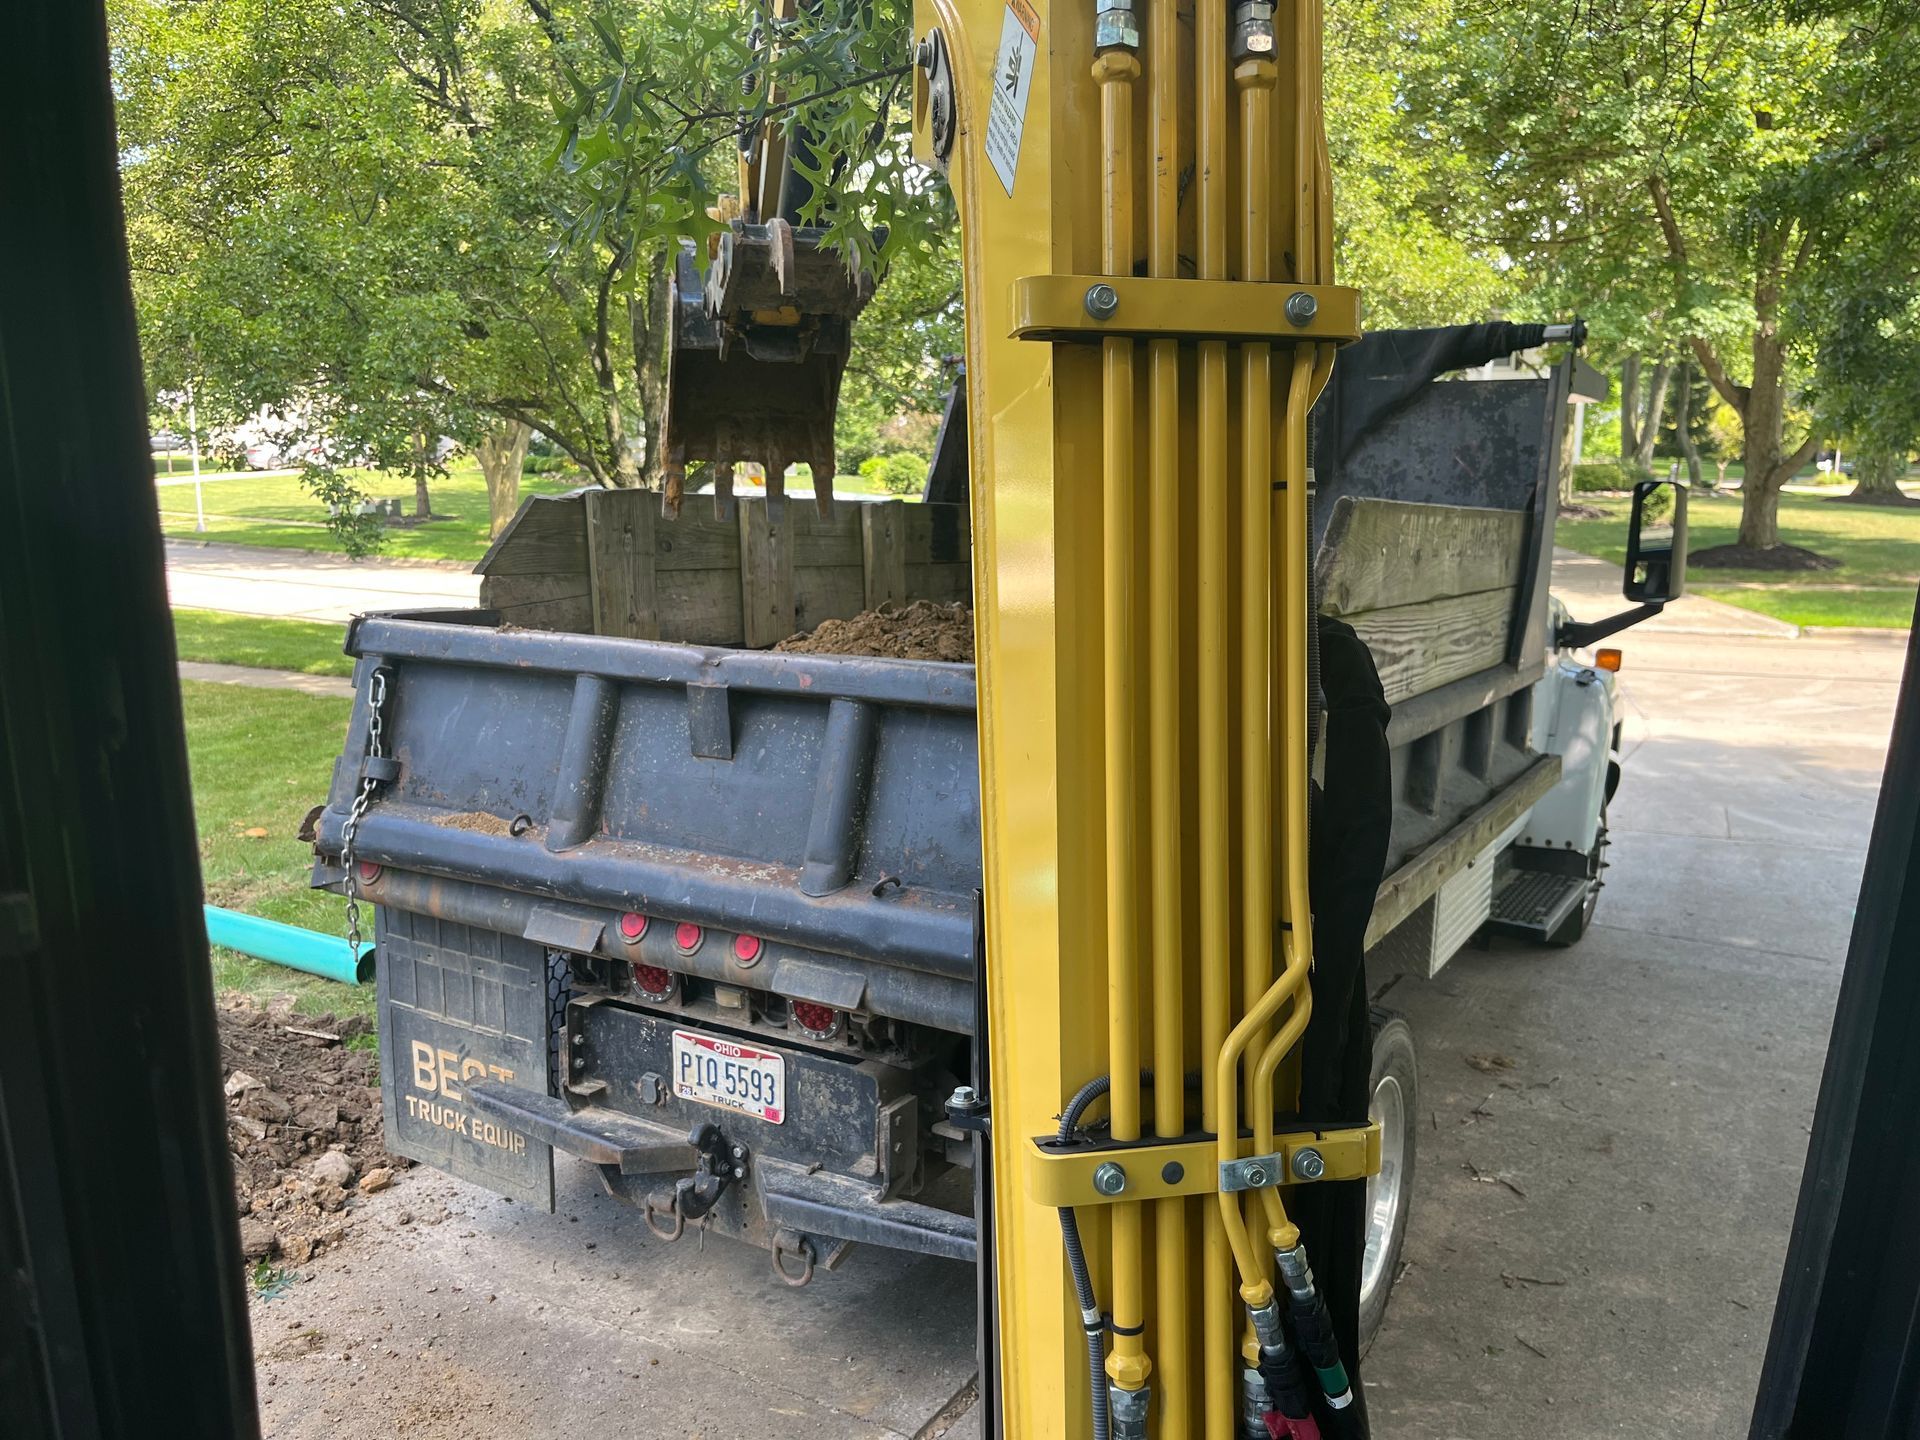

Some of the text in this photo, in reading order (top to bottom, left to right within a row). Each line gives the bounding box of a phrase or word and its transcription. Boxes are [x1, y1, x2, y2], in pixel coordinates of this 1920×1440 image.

[713, 1042, 741, 1057] OHIO
[681, 1051, 775, 1106] PIQ 5593
[711, 1094, 745, 1110] TRUCK
[405, 1095, 527, 1157] TRUCK EQUIP.
